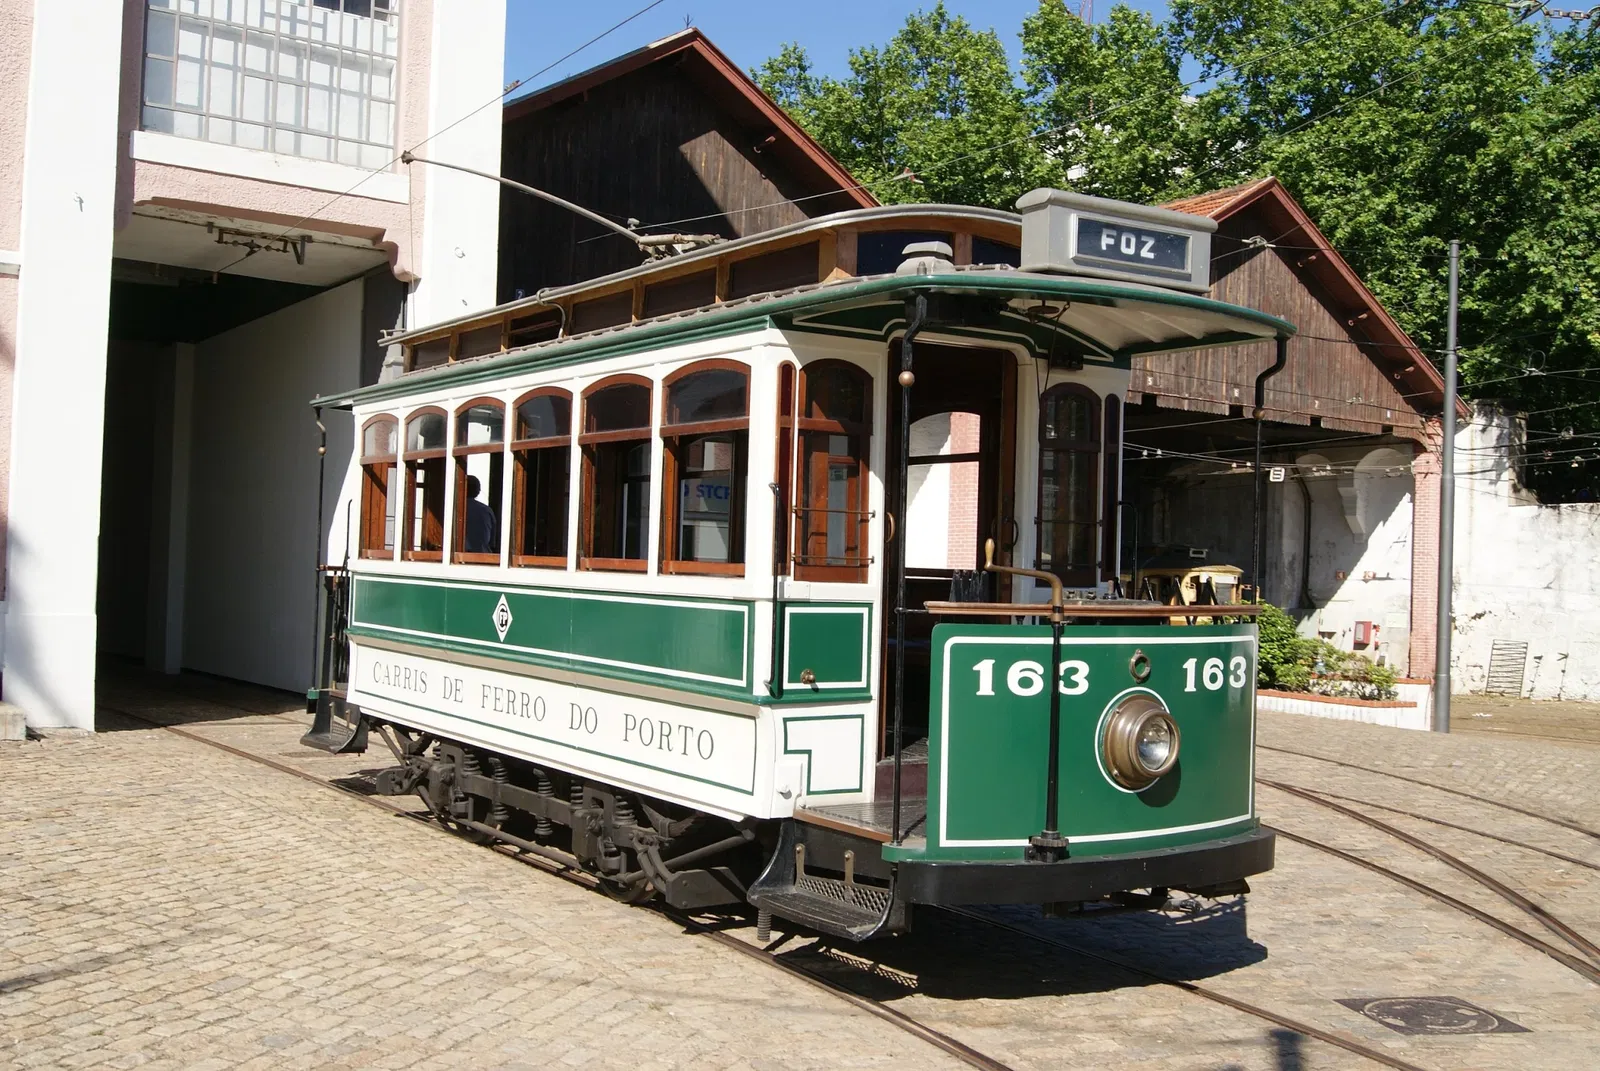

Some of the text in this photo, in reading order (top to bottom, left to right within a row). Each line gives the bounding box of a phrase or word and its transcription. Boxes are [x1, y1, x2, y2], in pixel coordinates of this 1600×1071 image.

[1100, 227, 1156, 259] FOZ
[972, 659, 1090, 696] 163
[1182, 655, 1247, 693] 163
[373, 661, 714, 760] CARRIS DE FERRO DO PORTO
